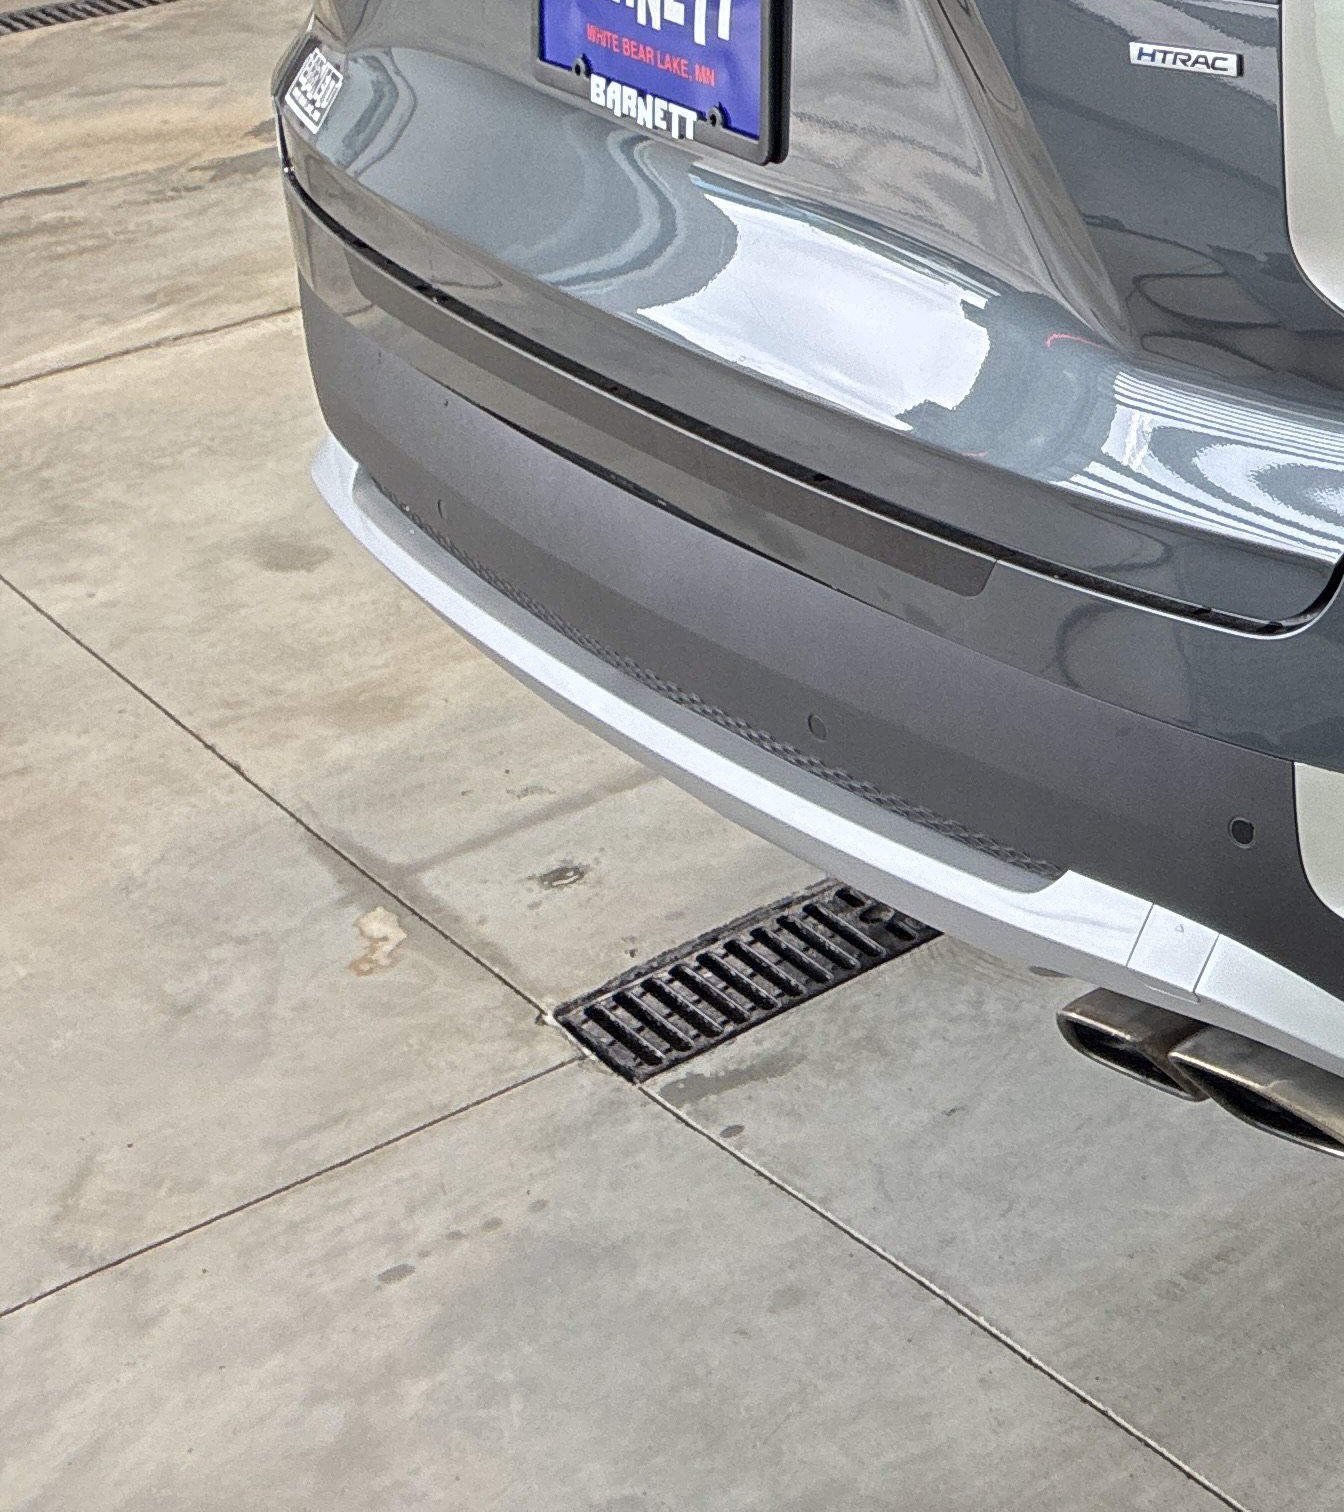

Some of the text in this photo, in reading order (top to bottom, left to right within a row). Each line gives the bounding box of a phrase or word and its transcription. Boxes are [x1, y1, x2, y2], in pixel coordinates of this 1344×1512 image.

[586, 23, 715, 87] WHITE BEAR LAKE, MN
[1136, 46, 1229, 72] HTRAC
[590, 73, 698, 141] BARNETT
